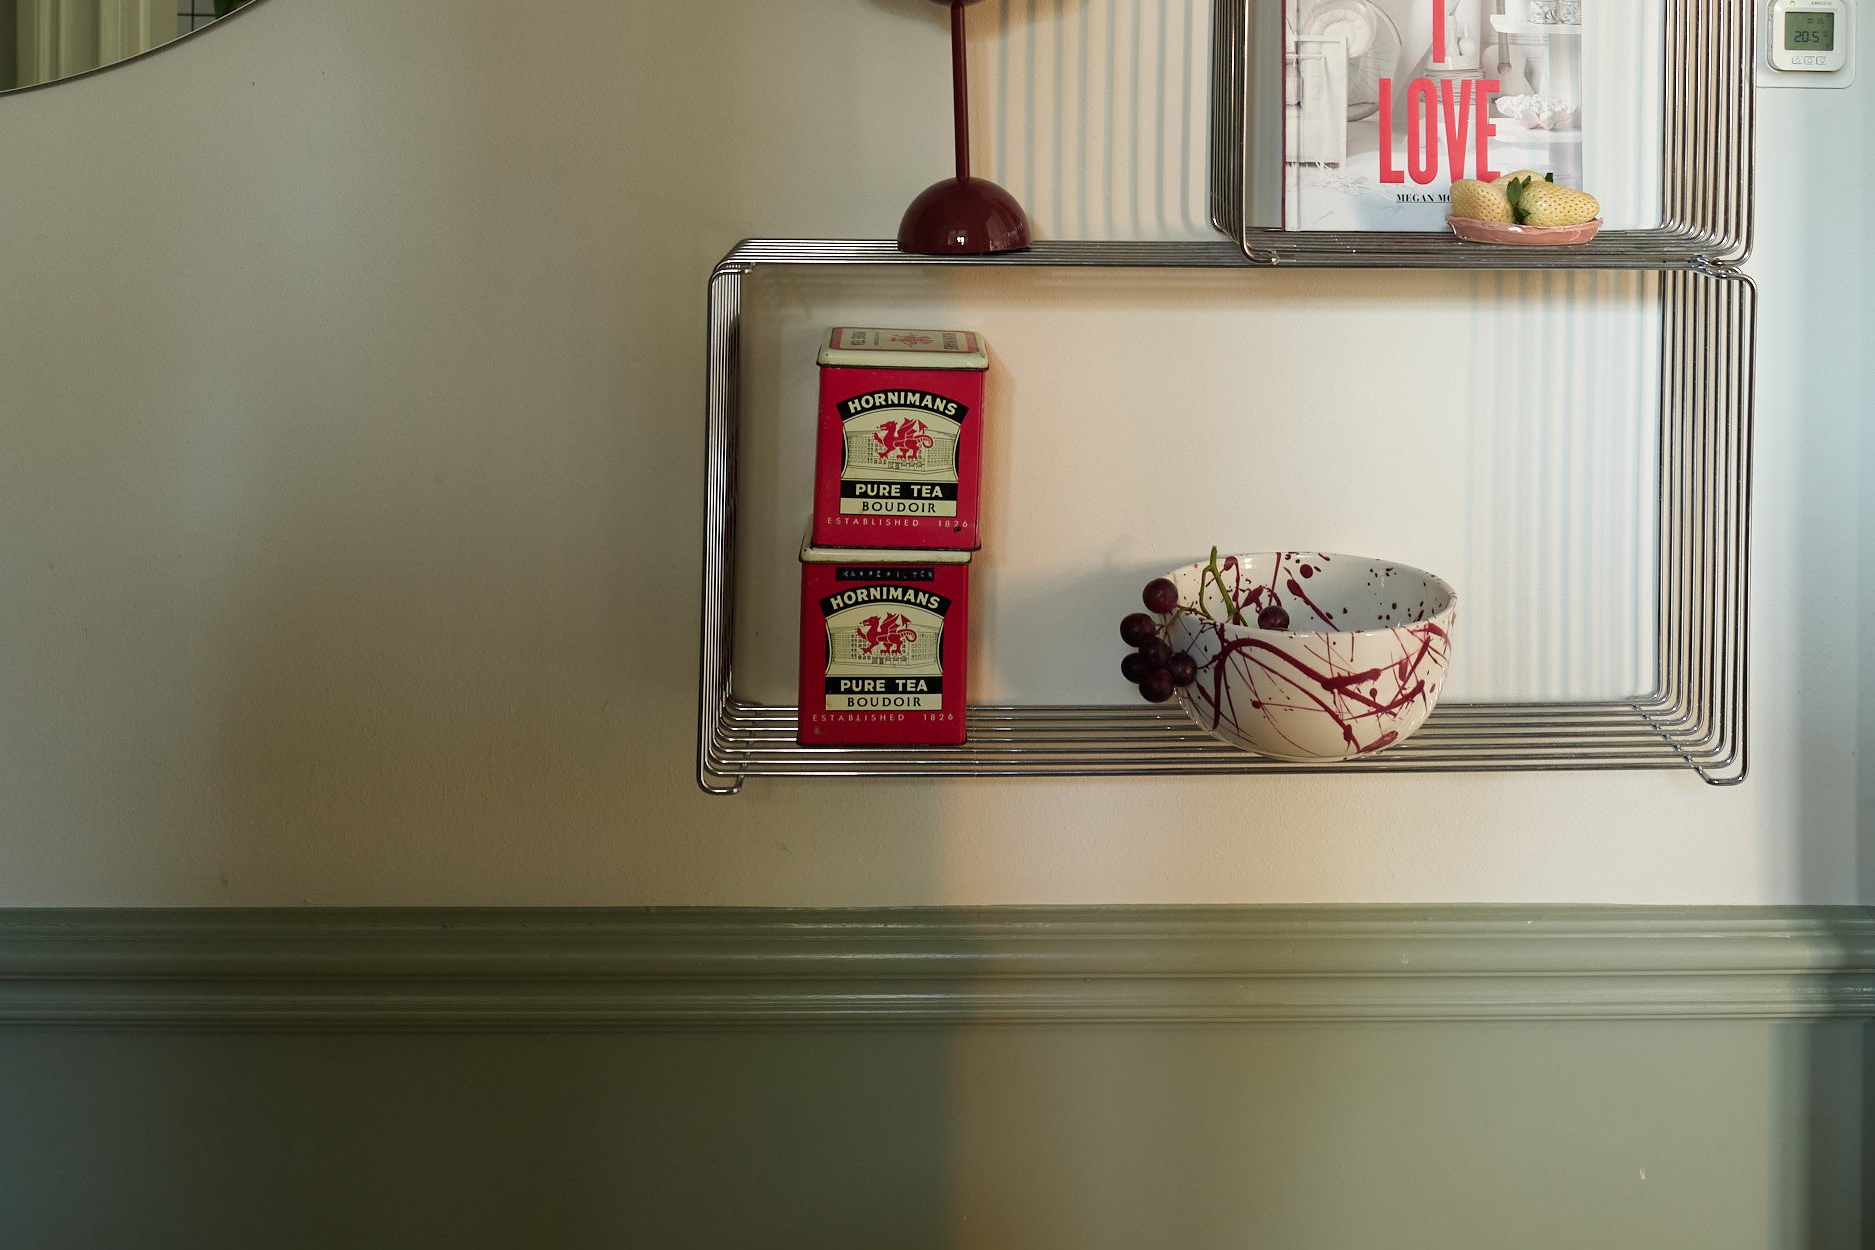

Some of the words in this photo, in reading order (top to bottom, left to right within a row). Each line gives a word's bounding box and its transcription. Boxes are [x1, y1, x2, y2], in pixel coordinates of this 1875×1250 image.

[1794, 30, 1820, 43] 20.5
[1378, 77, 1501, 186] LOVE
[1396, 194, 1434, 202] MEGAN
[847, 391, 958, 416] HORNIMANS
[855, 483, 901, 497] PURE
[911, 485, 943, 498] TEA
[862, 501, 936, 513] BOUDOIR
[827, 517, 920, 527] ESTABLISHED
[938, 519, 969, 528] 1826
[830, 586, 941, 610] HORNIMANS
[840, 679, 886, 692] PURE
[895, 679, 928, 692] TEA
[847, 696, 922, 707] BOUDOIR
[813, 714, 905, 722] ESTABLISHED
[923, 713, 954, 721] 1826
